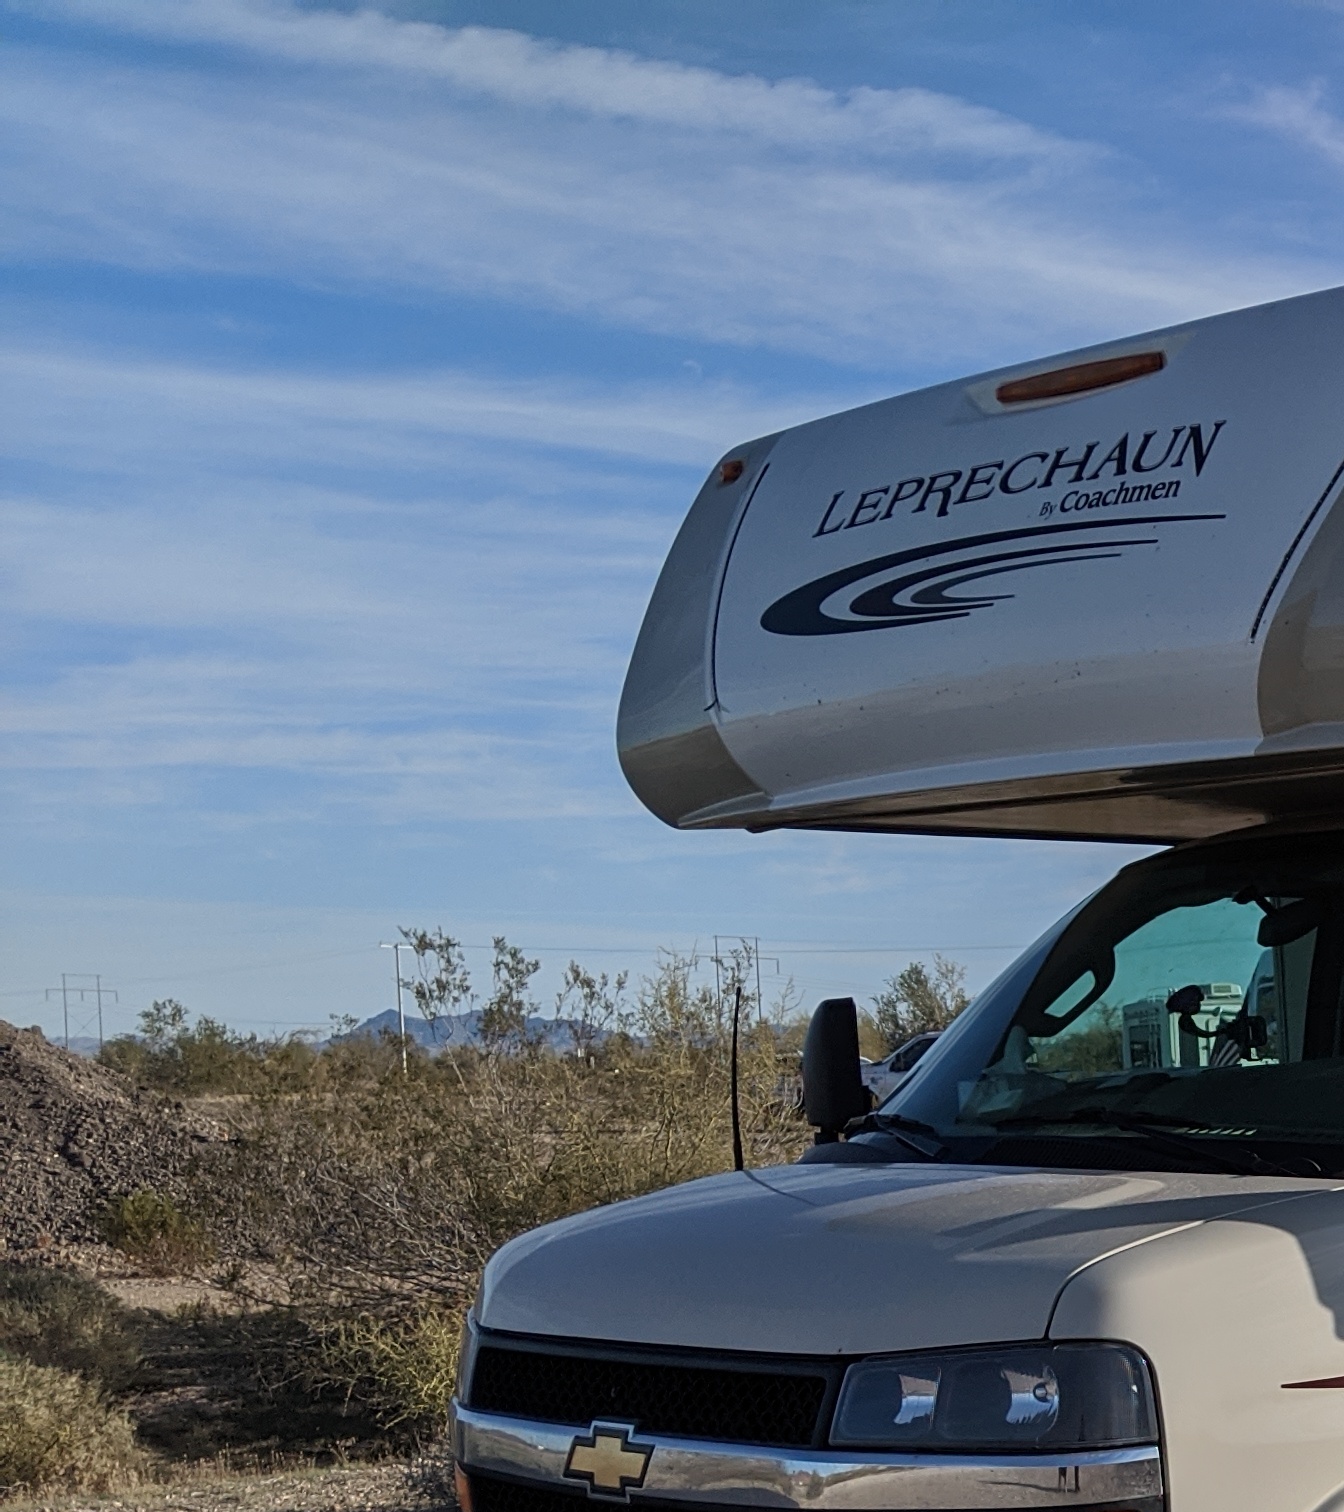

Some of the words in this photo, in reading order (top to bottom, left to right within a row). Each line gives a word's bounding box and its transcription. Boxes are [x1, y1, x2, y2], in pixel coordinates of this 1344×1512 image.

[812, 419, 1227, 538] LEPRECHAUN
[1040, 502, 1057, 520] By
[1059, 479, 1181, 514] Coachmen
